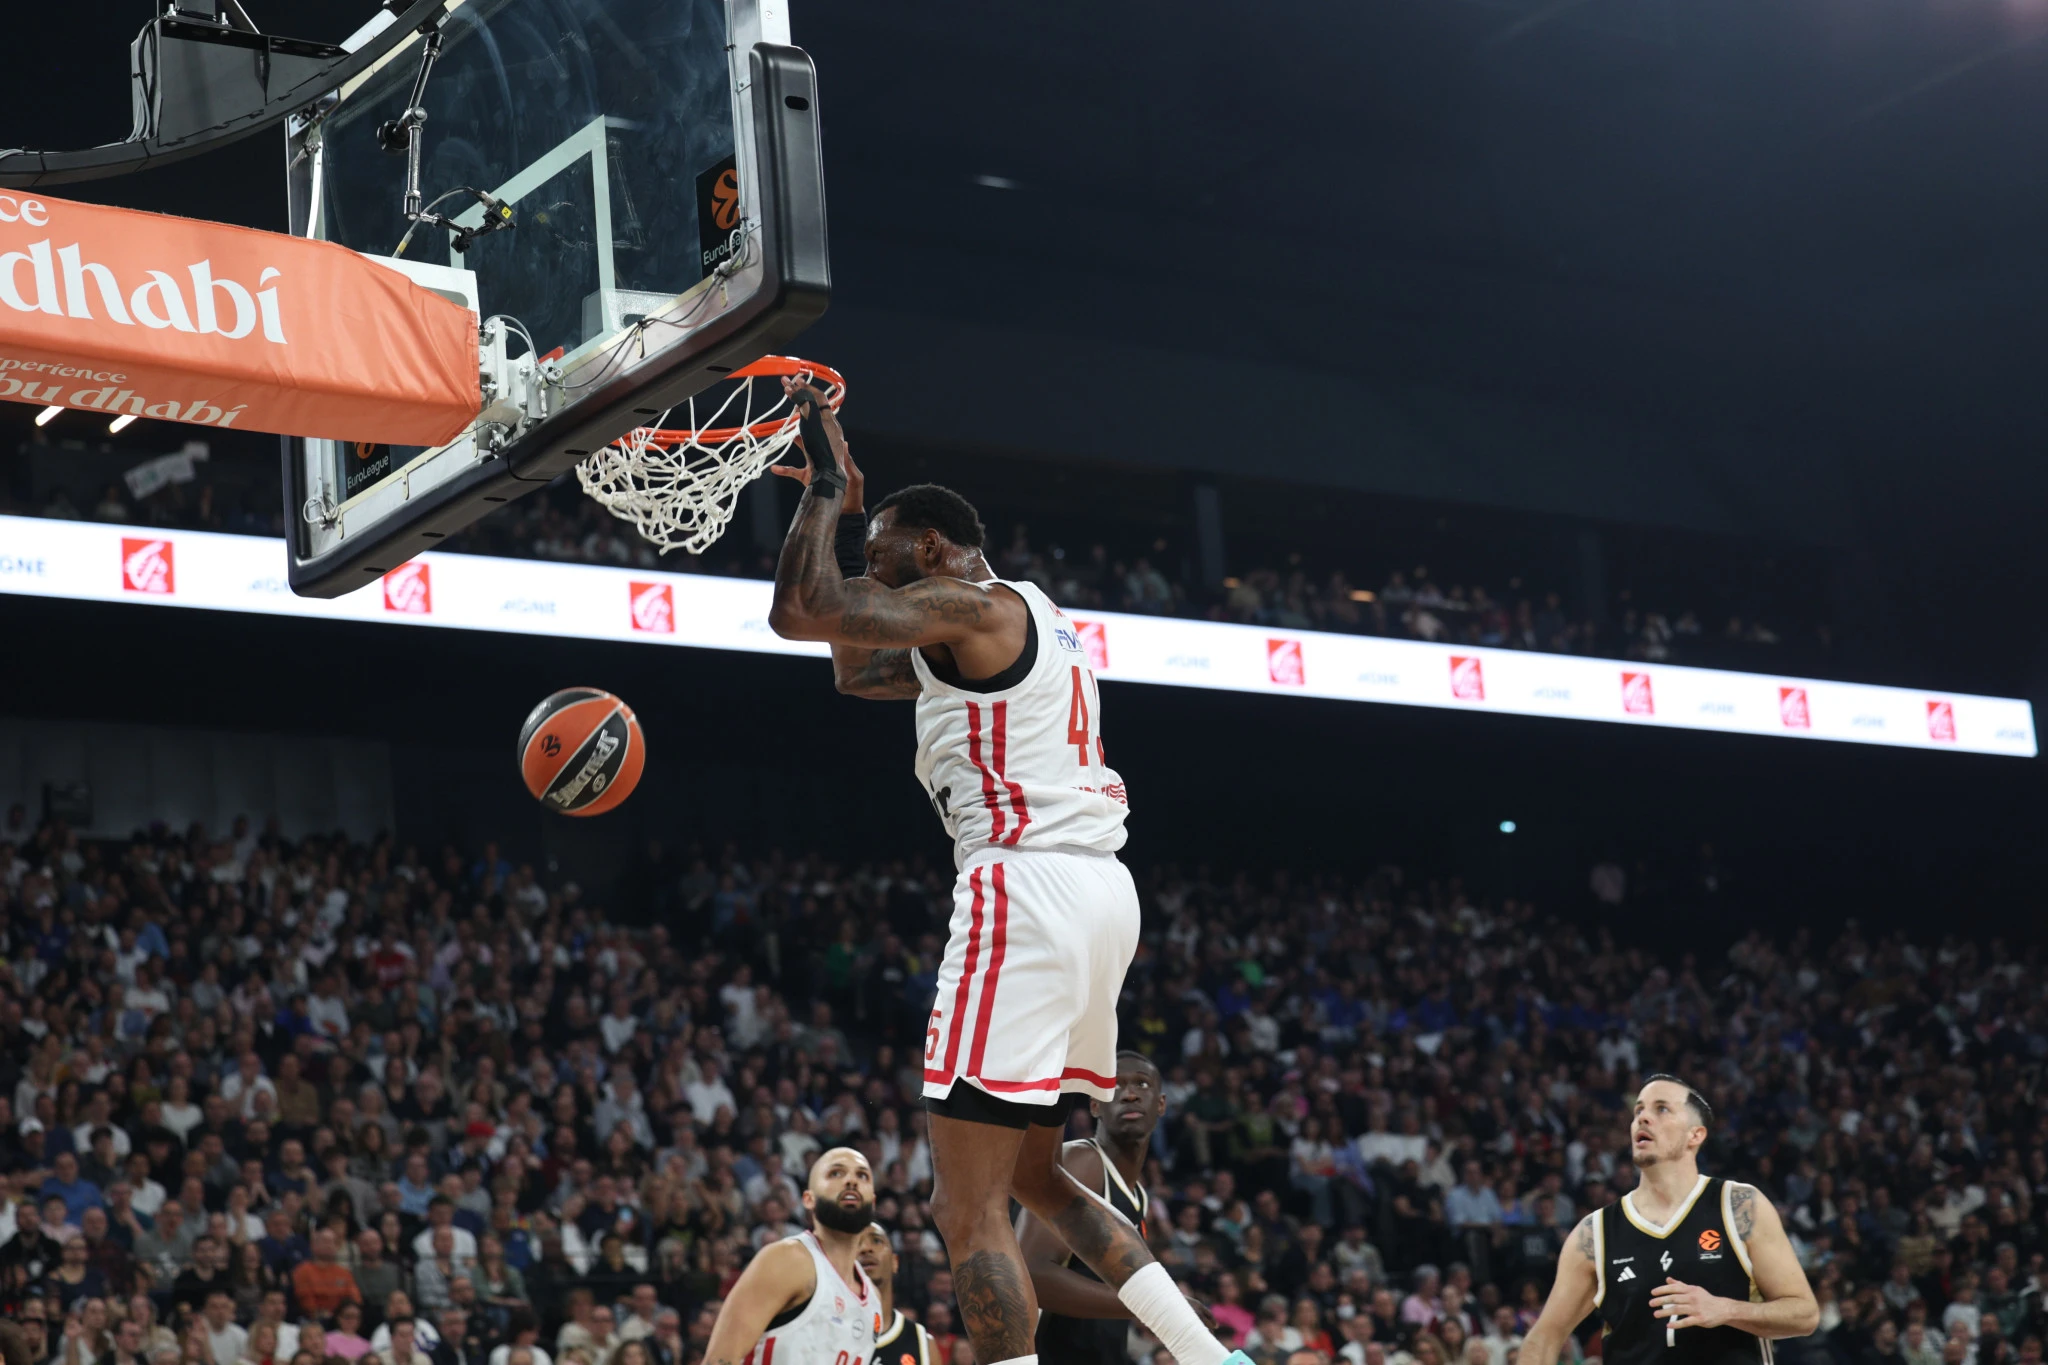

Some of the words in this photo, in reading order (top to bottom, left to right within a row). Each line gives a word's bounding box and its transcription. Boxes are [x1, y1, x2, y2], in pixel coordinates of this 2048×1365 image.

[0, 359, 127, 384] perience
[347, 455, 389, 490] EuroLeague
[547, 728, 620, 808] SPALDING
